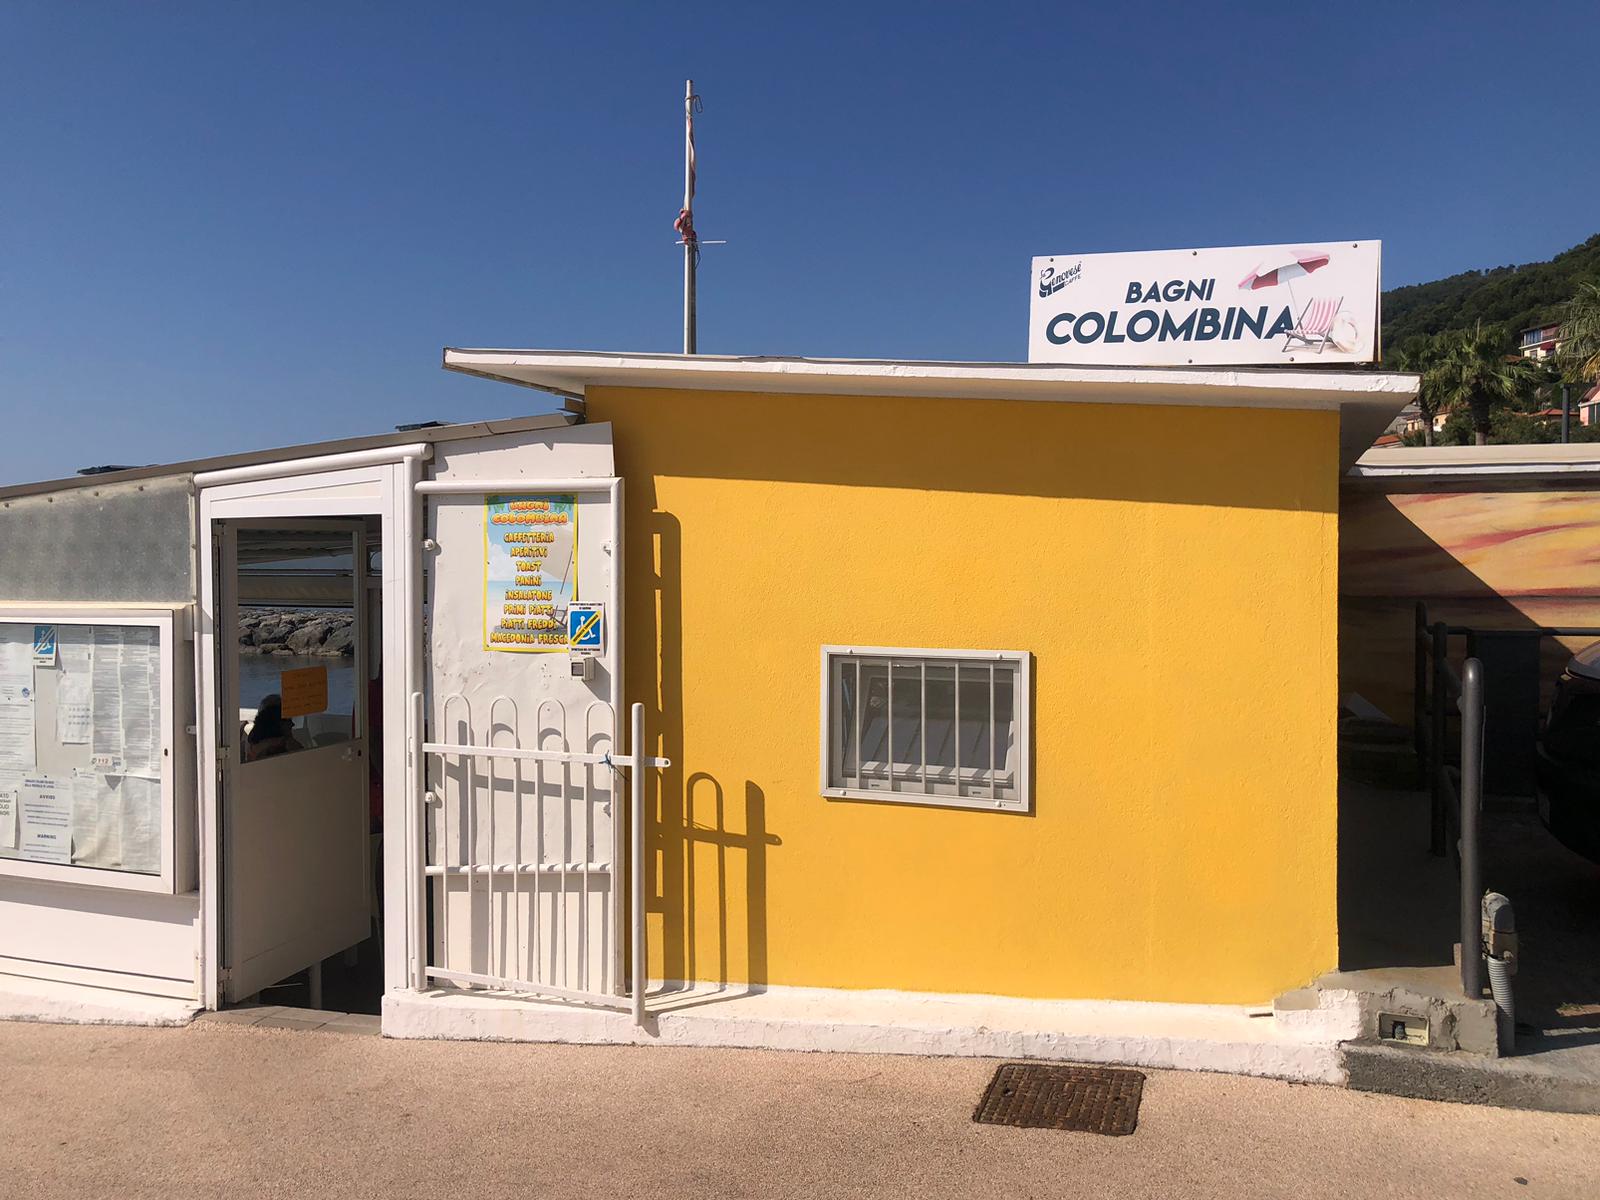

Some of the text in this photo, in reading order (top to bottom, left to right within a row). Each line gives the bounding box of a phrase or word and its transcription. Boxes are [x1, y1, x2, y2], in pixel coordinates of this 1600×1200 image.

[1125, 278, 1216, 303] BAGNI
[1046, 305, 1295, 345] COLOMBINA
[516, 561, 541, 572] TOAST
